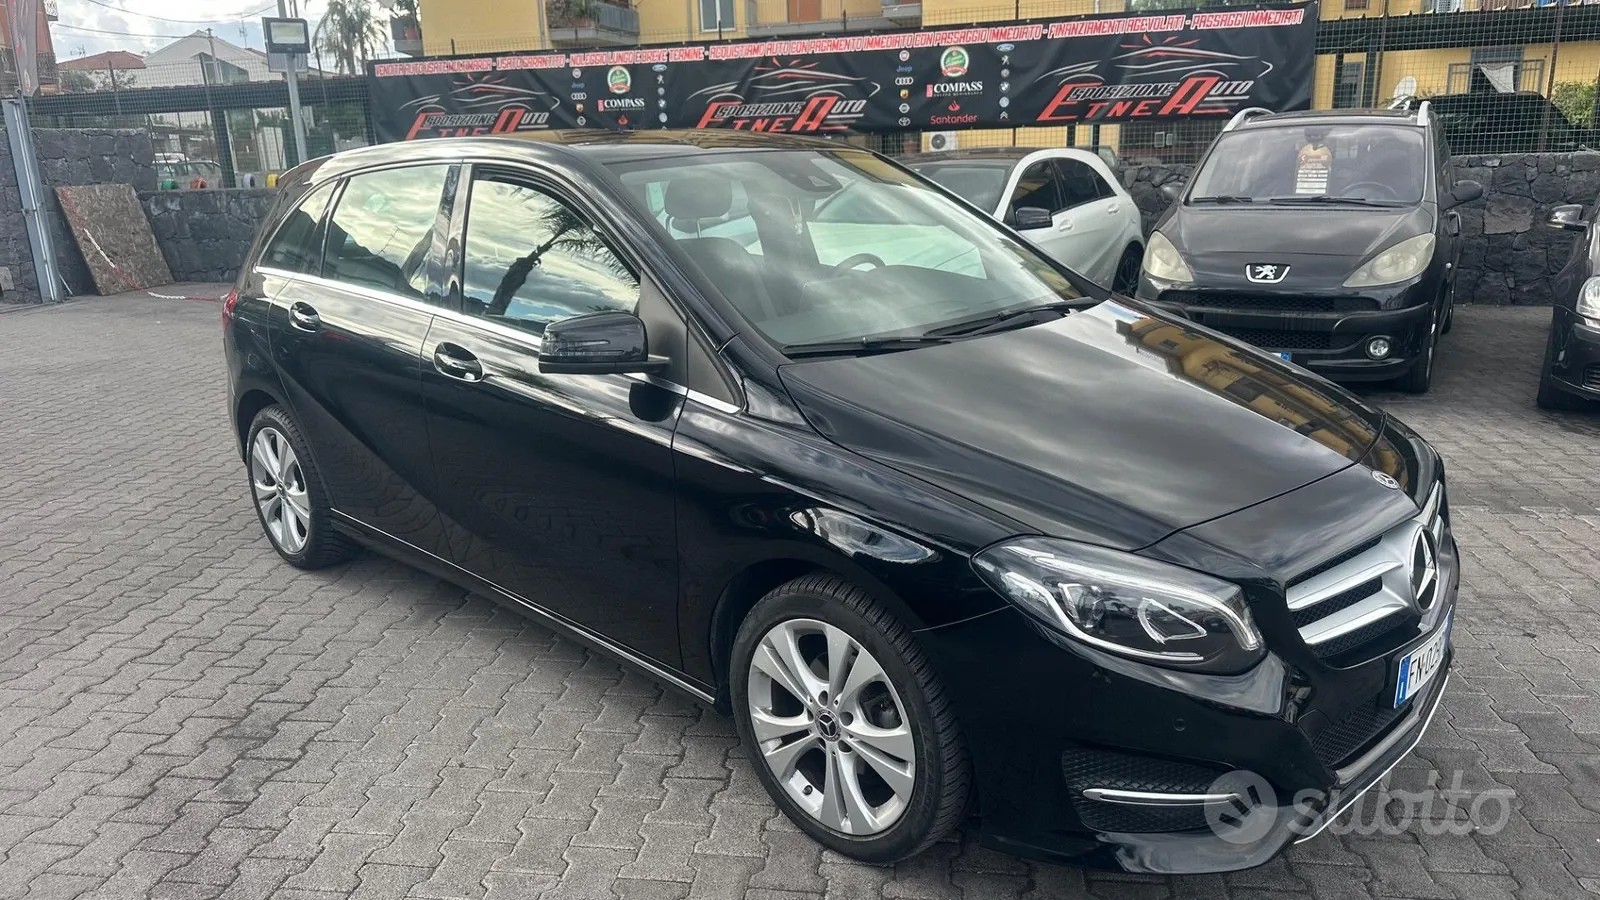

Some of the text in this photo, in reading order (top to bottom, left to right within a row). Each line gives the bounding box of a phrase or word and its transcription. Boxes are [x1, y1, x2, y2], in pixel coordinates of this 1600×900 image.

[570, 52, 608, 67] NOLEGGIO
[608, 50, 633, 65] LUNGO
[668, 47, 704, 62] TERMINE
[709, 43, 765, 59] ACQUISTIAMO
[765, 40, 789, 56] AUTO
[790, 39, 808, 55] CON
[809, 37, 862, 54] PAGAMENTO
[863, 33, 913, 50] IMMEDIATO
[914, 32, 934, 48] CON
[934, 29, 988, 46] PASSAGGIO
[988, 25, 1043, 43] IMMEDIATO
[1048, 20, 1125, 39] FINANZIAMENTI
[1125, 15, 1186, 33] AGEVOLATI
[1191, 12, 1246, 29] PASSAGGI
[1246, 9, 1304, 27] IMMEDIATI
[896, 65, 912, 74] Jeep
[934, 81, 983, 93] COMPASS
[604, 98, 645, 109] COMPASS
[930, 114, 978, 124] Santander
